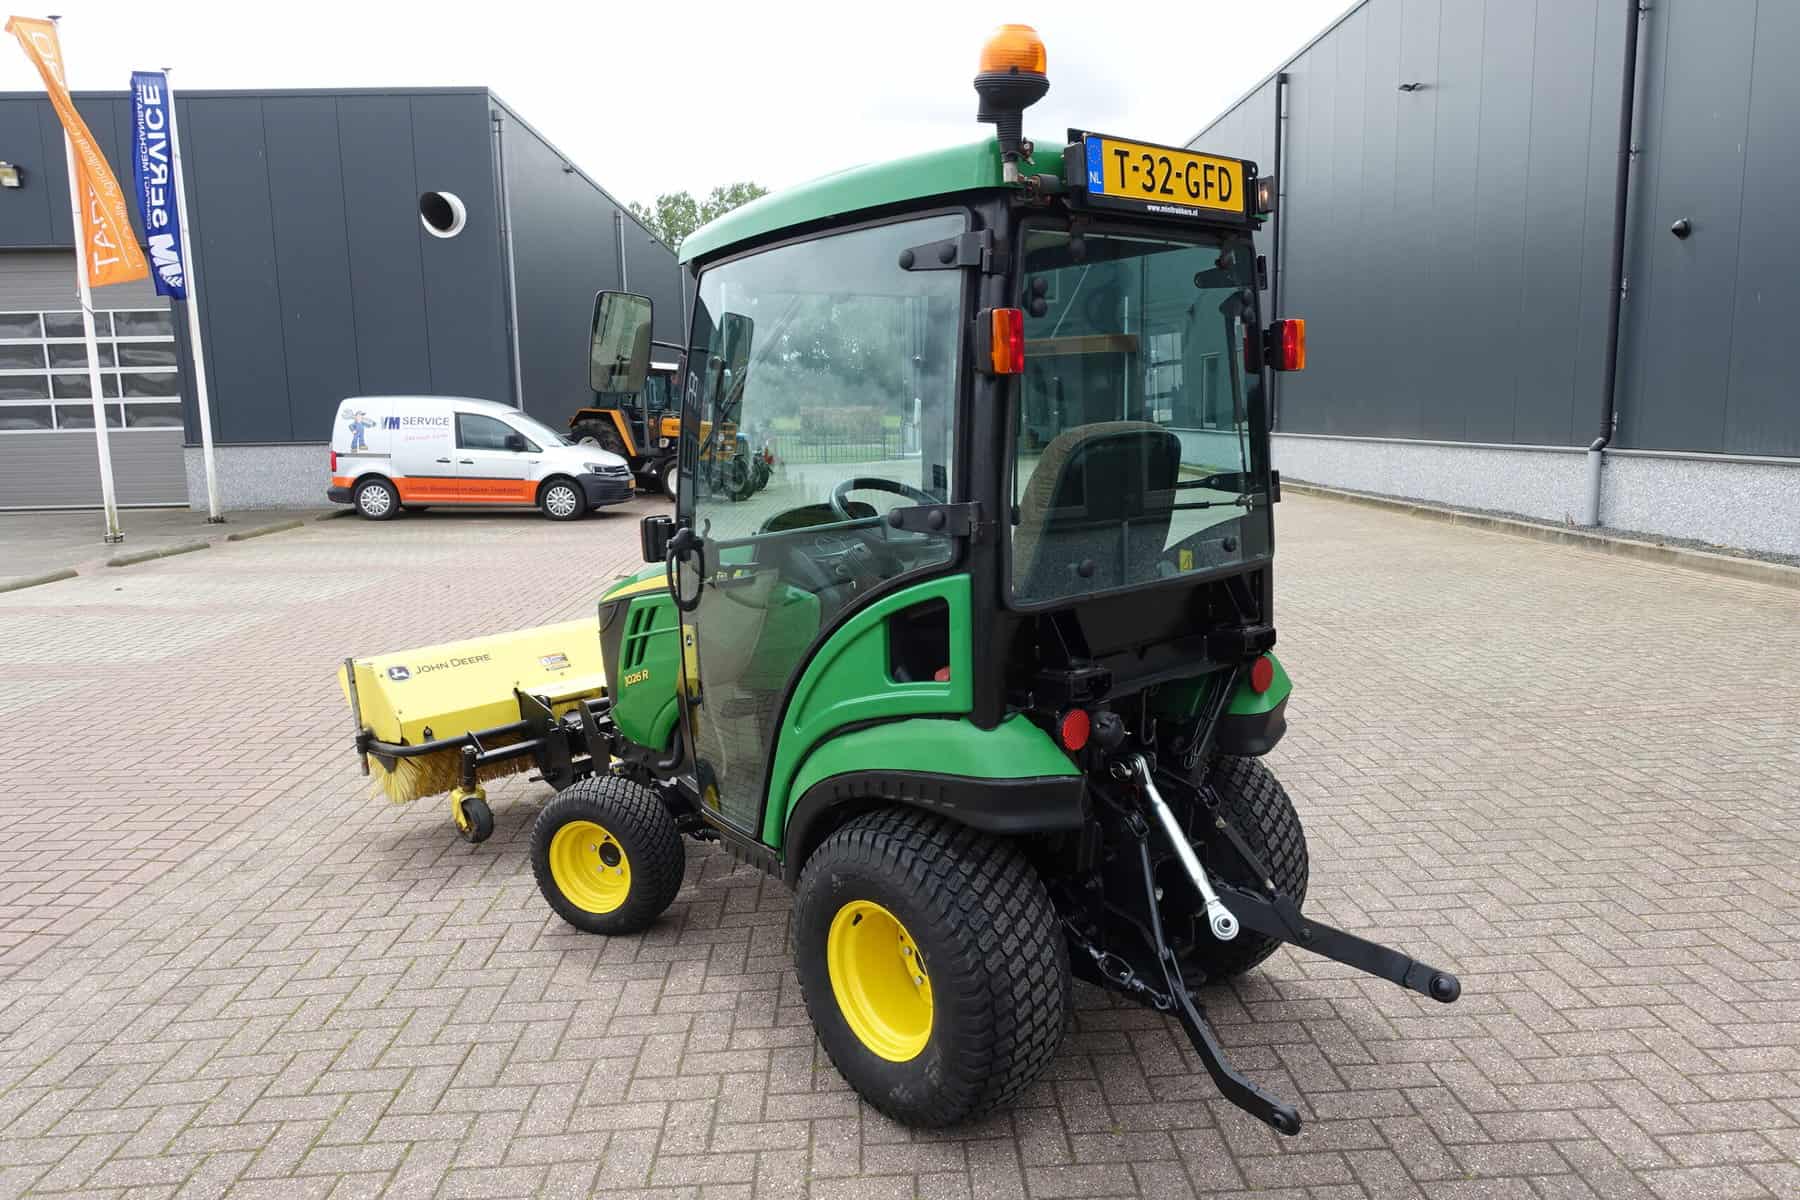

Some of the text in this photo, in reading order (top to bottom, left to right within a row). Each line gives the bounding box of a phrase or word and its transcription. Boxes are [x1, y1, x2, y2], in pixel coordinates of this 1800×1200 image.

[1089, 170, 1102, 184] NL
[1114, 149, 1232, 202] T-32-GFD
[402, 416, 449, 426] SERVICE
[416, 654, 491, 674] JOHN DEERE
